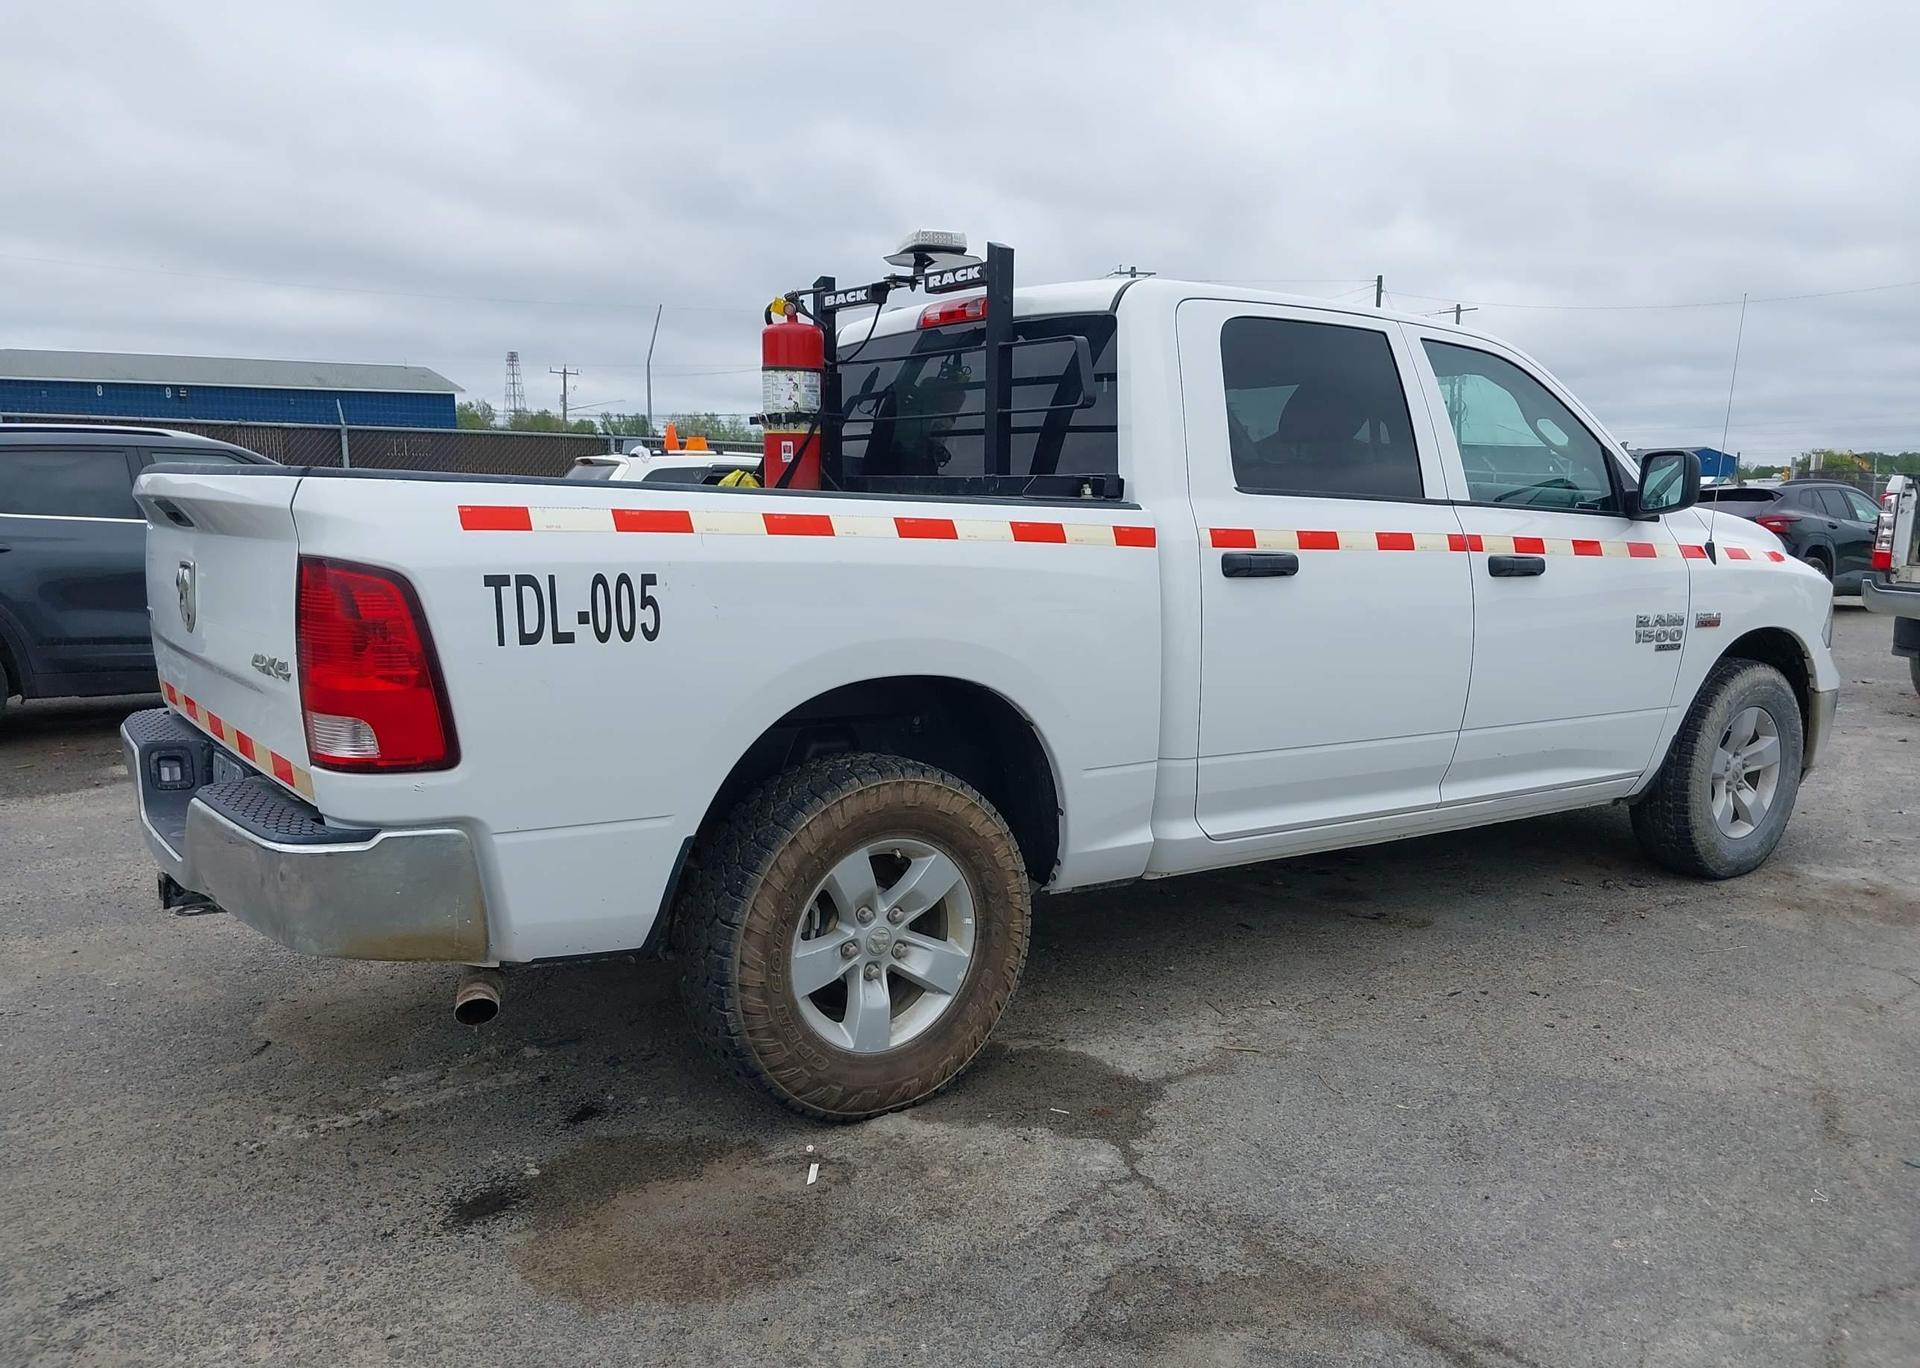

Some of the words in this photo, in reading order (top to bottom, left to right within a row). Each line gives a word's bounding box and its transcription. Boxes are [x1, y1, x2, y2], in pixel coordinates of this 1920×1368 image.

[824, 288, 868, 307] BACK
[928, 265, 982, 288] RACK
[96, 384, 103, 397] 8
[165, 386, 172, 399] 9
[483, 572, 661, 647] TDL-005
[1635, 613, 1685, 628] RAM
[1634, 628, 1683, 644] 1500
